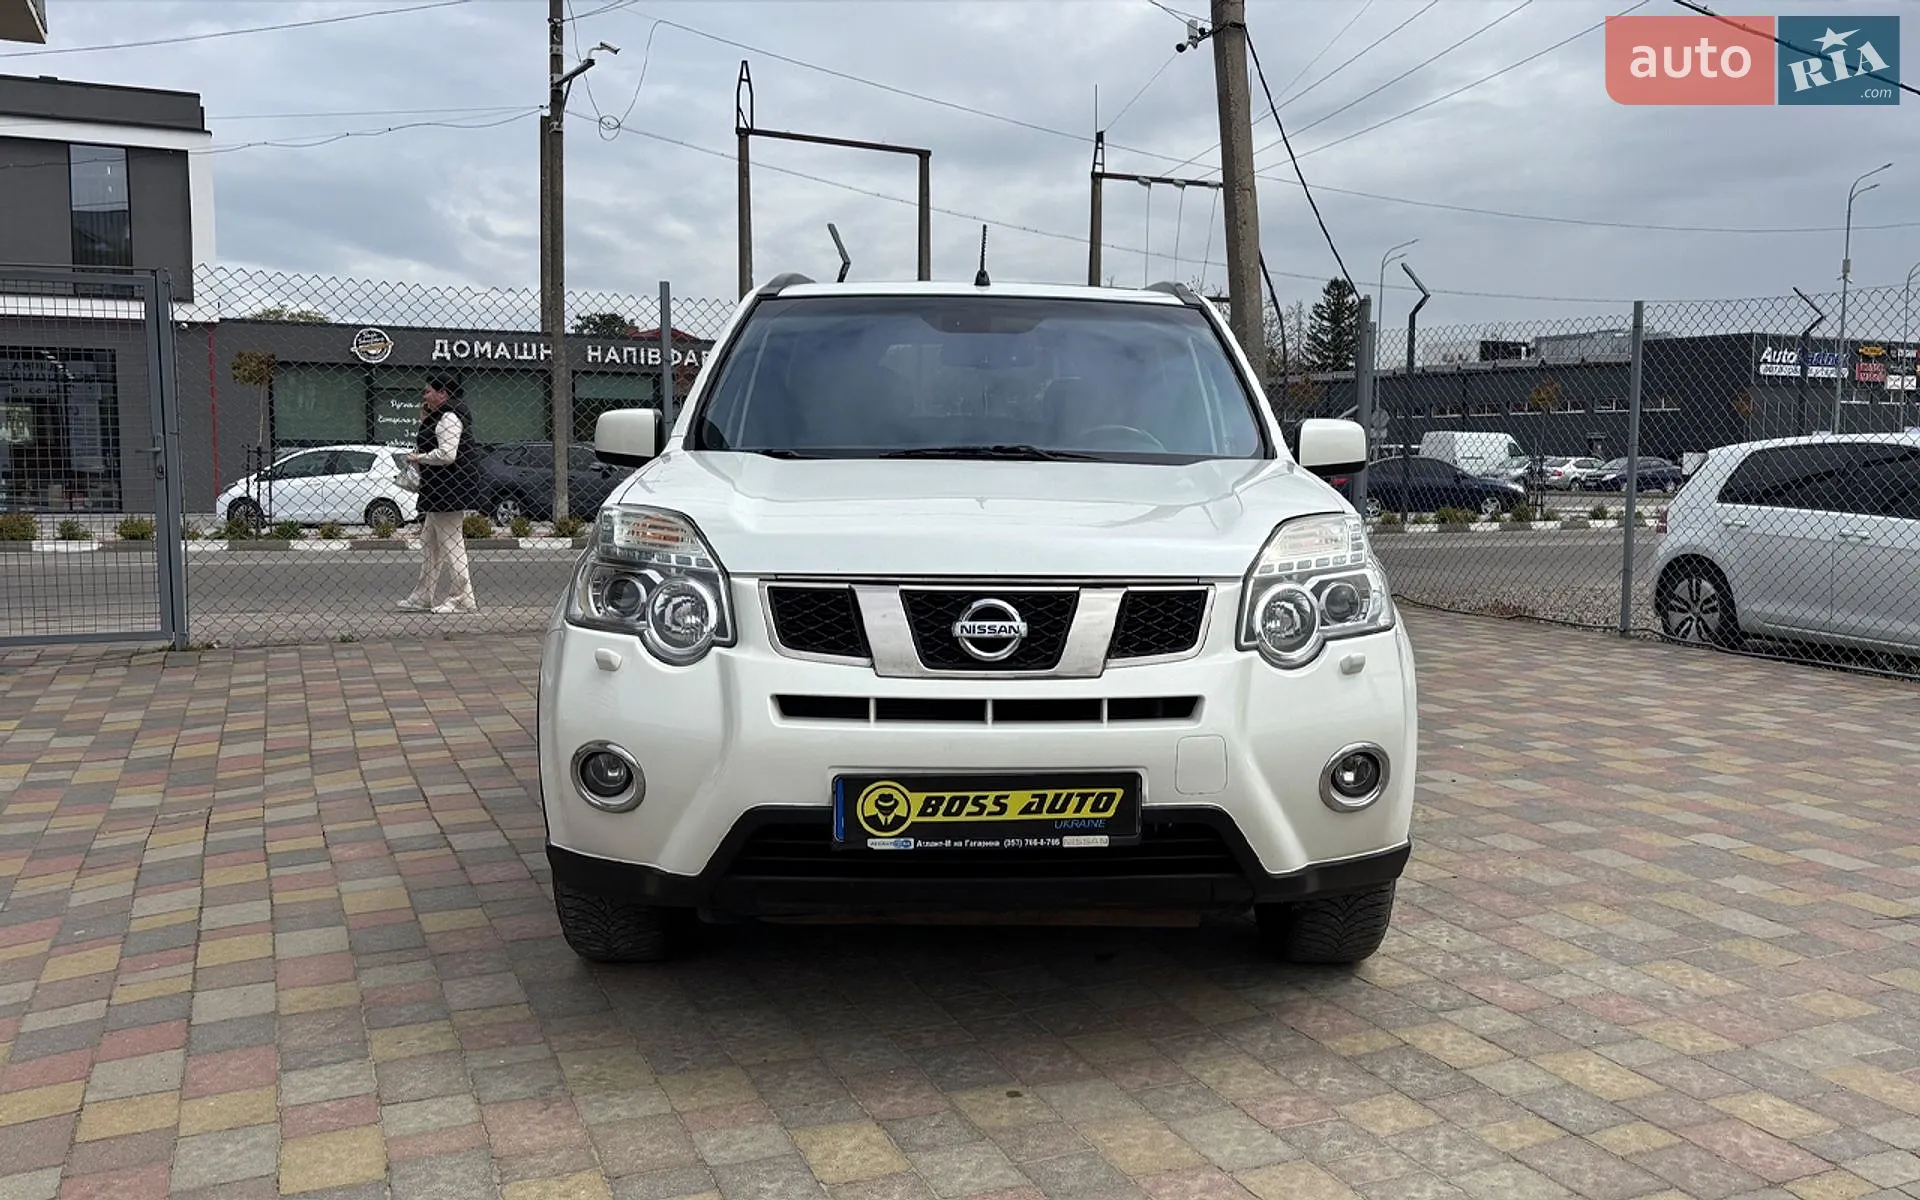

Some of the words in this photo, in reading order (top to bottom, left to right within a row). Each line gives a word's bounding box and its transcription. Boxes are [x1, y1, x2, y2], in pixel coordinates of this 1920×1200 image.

[960, 624, 1020, 635] NISSAN
[917, 794, 1010, 817] BOSS
[1017, 792, 1117, 816] AUTO
[1054, 819, 1107, 830] UKRAINE
